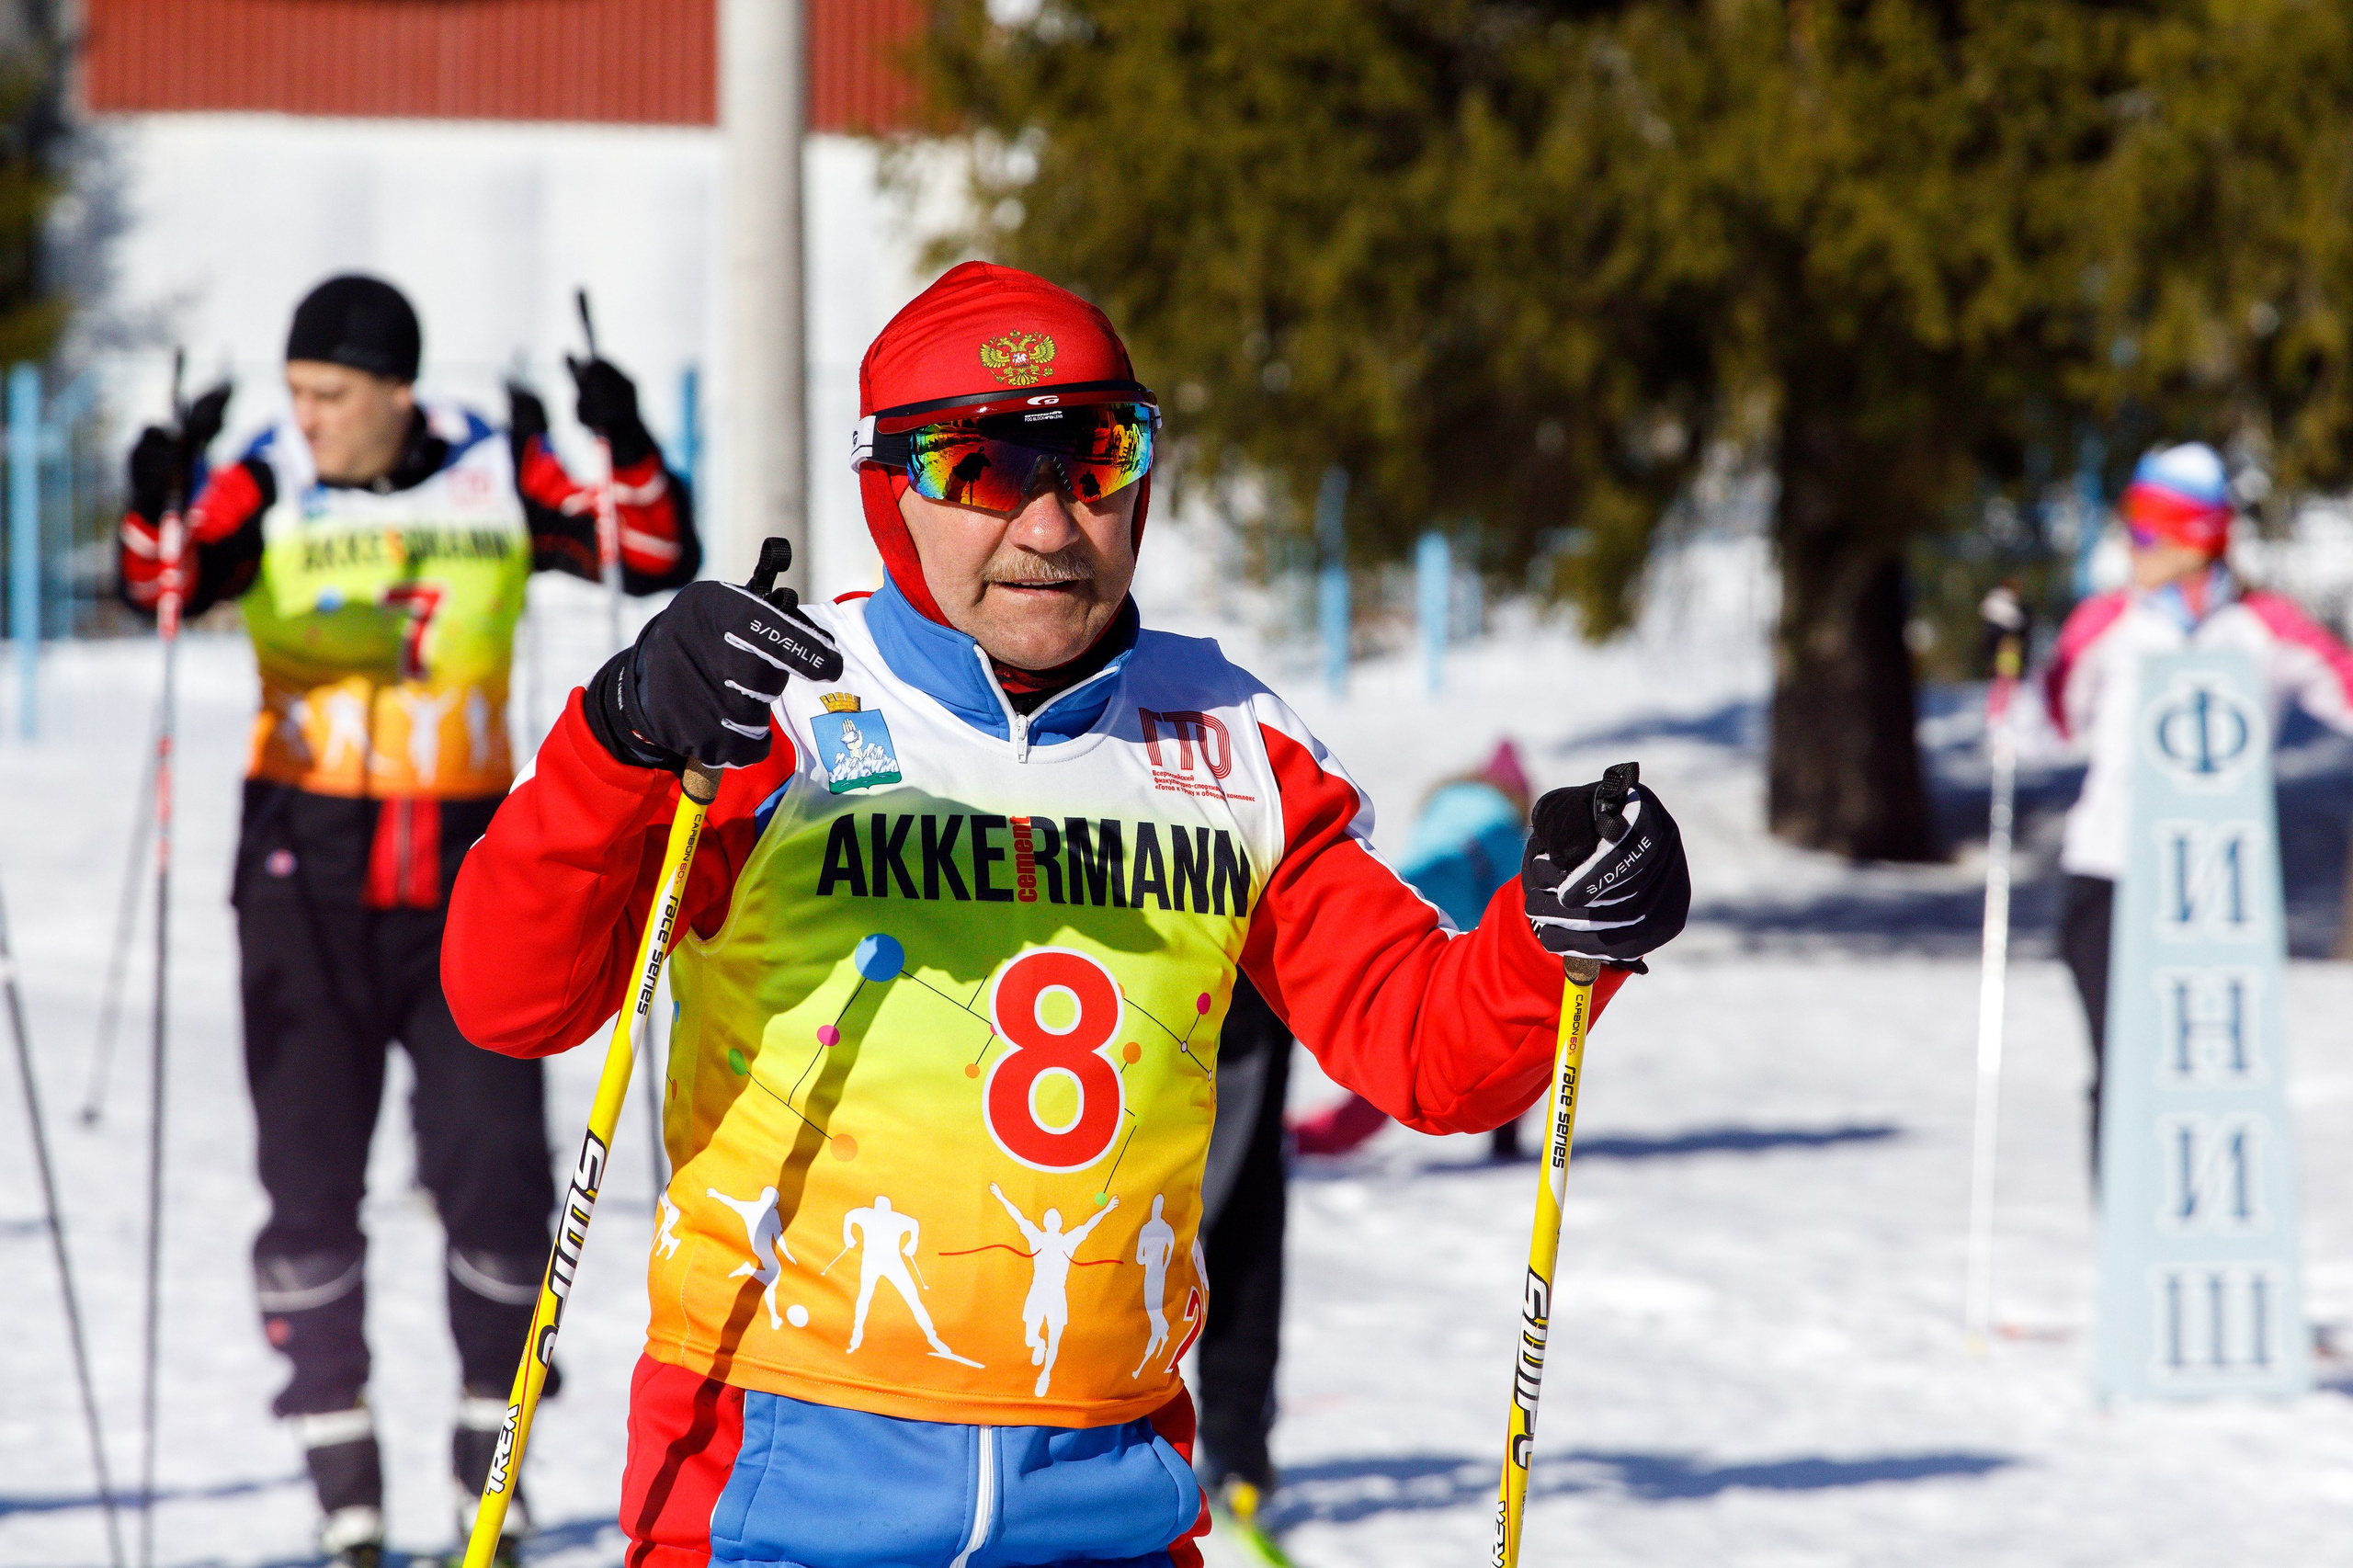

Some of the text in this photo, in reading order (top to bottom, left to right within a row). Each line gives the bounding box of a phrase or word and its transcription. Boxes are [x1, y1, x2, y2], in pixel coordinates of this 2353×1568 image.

[382, 585, 445, 682] 7
[683, 813, 702, 862] CARBON
[816, 812, 1252, 918] AKKERMANN
[1009, 815, 1038, 903] cement
[637, 894, 679, 1017] race series
[982, 945, 1126, 1174] 8
[1573, 994, 1584, 1036] CARBON
[2156, 686, 2270, 1371] ФИНИШ
[1552, 1063, 1576, 1169] race series
